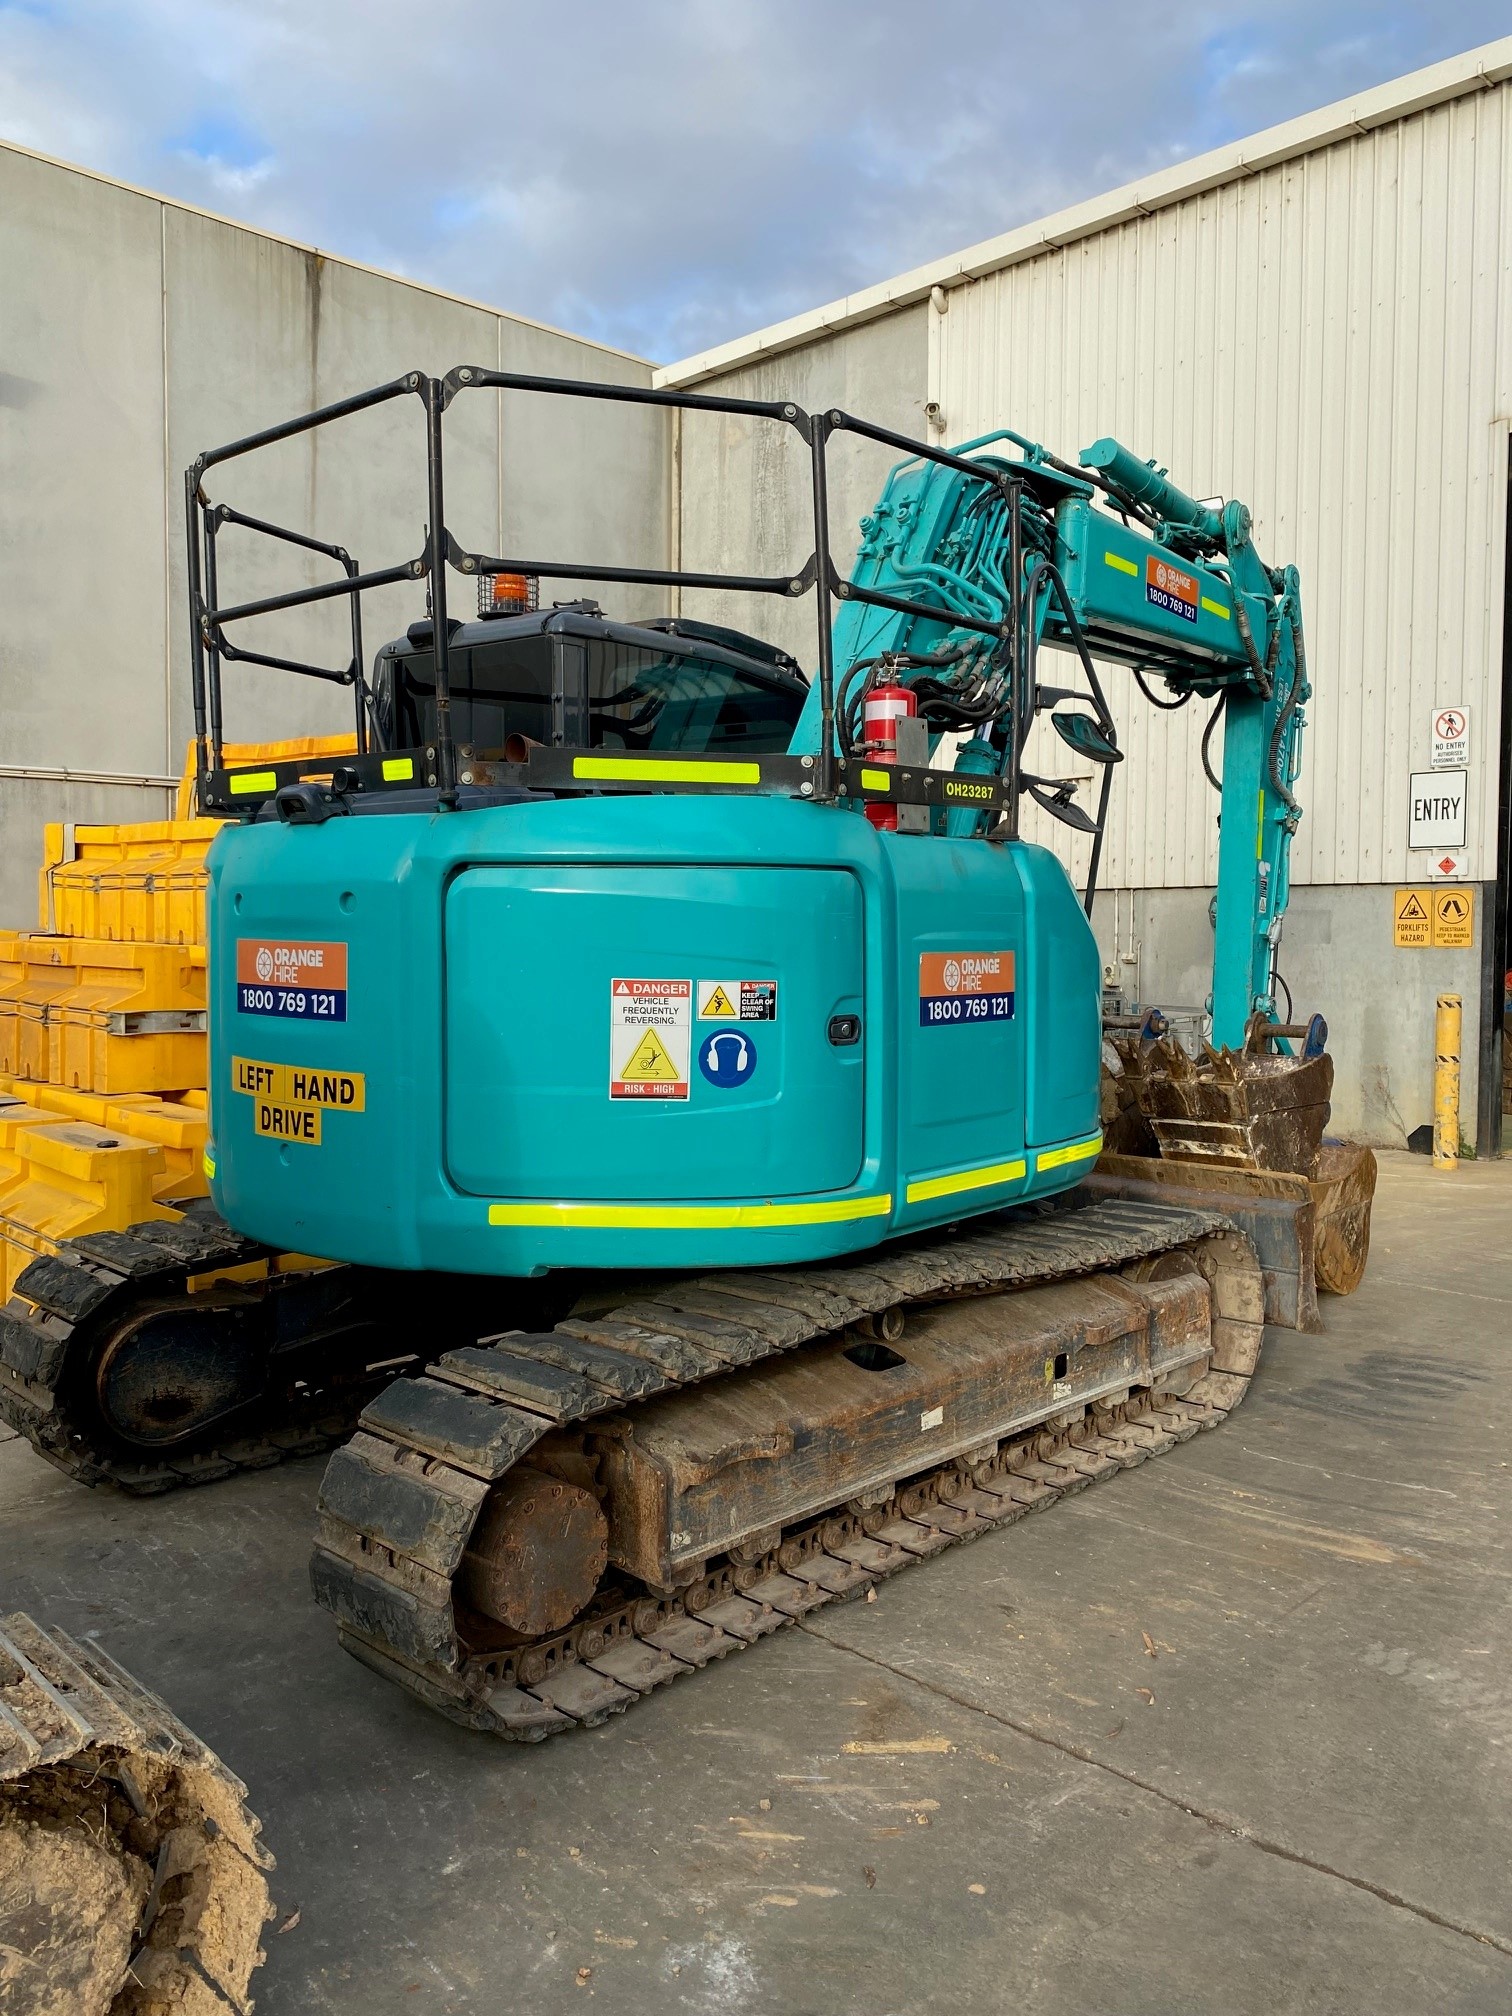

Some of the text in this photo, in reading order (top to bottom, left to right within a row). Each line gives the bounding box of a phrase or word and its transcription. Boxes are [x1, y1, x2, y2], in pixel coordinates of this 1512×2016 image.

[1168, 569, 1190, 590] ORANGE
[1168, 580, 1179, 595] HIRE
[1150, 588, 1194, 619] 1800 769 121
[1446, 742, 1466, 750] ENTRY
[946, 782, 994, 799] OH23287
[1414, 797, 1461, 821] ENTRY
[1400, 934, 1425, 942] HAZARD
[274, 947, 323, 967] ORANGE
[274, 966, 298, 984] HIRE
[961, 959, 1000, 974] ORANGE
[633, 983, 688, 994] DANGER
[961, 975, 982, 991] HIRE
[243, 989, 335, 1015] 1800 769 121
[632, 997, 669, 1005] VEHICLE
[928, 997, 1008, 1019] 1800 769 121
[625, 1016, 676, 1024] REVERSING.
[239, 1063, 355, 1105] LEFT HAND
[624, 1084, 645, 1093] RISK
[653, 1084, 675, 1093] HIGH
[261, 1105, 315, 1139] DRIVE
